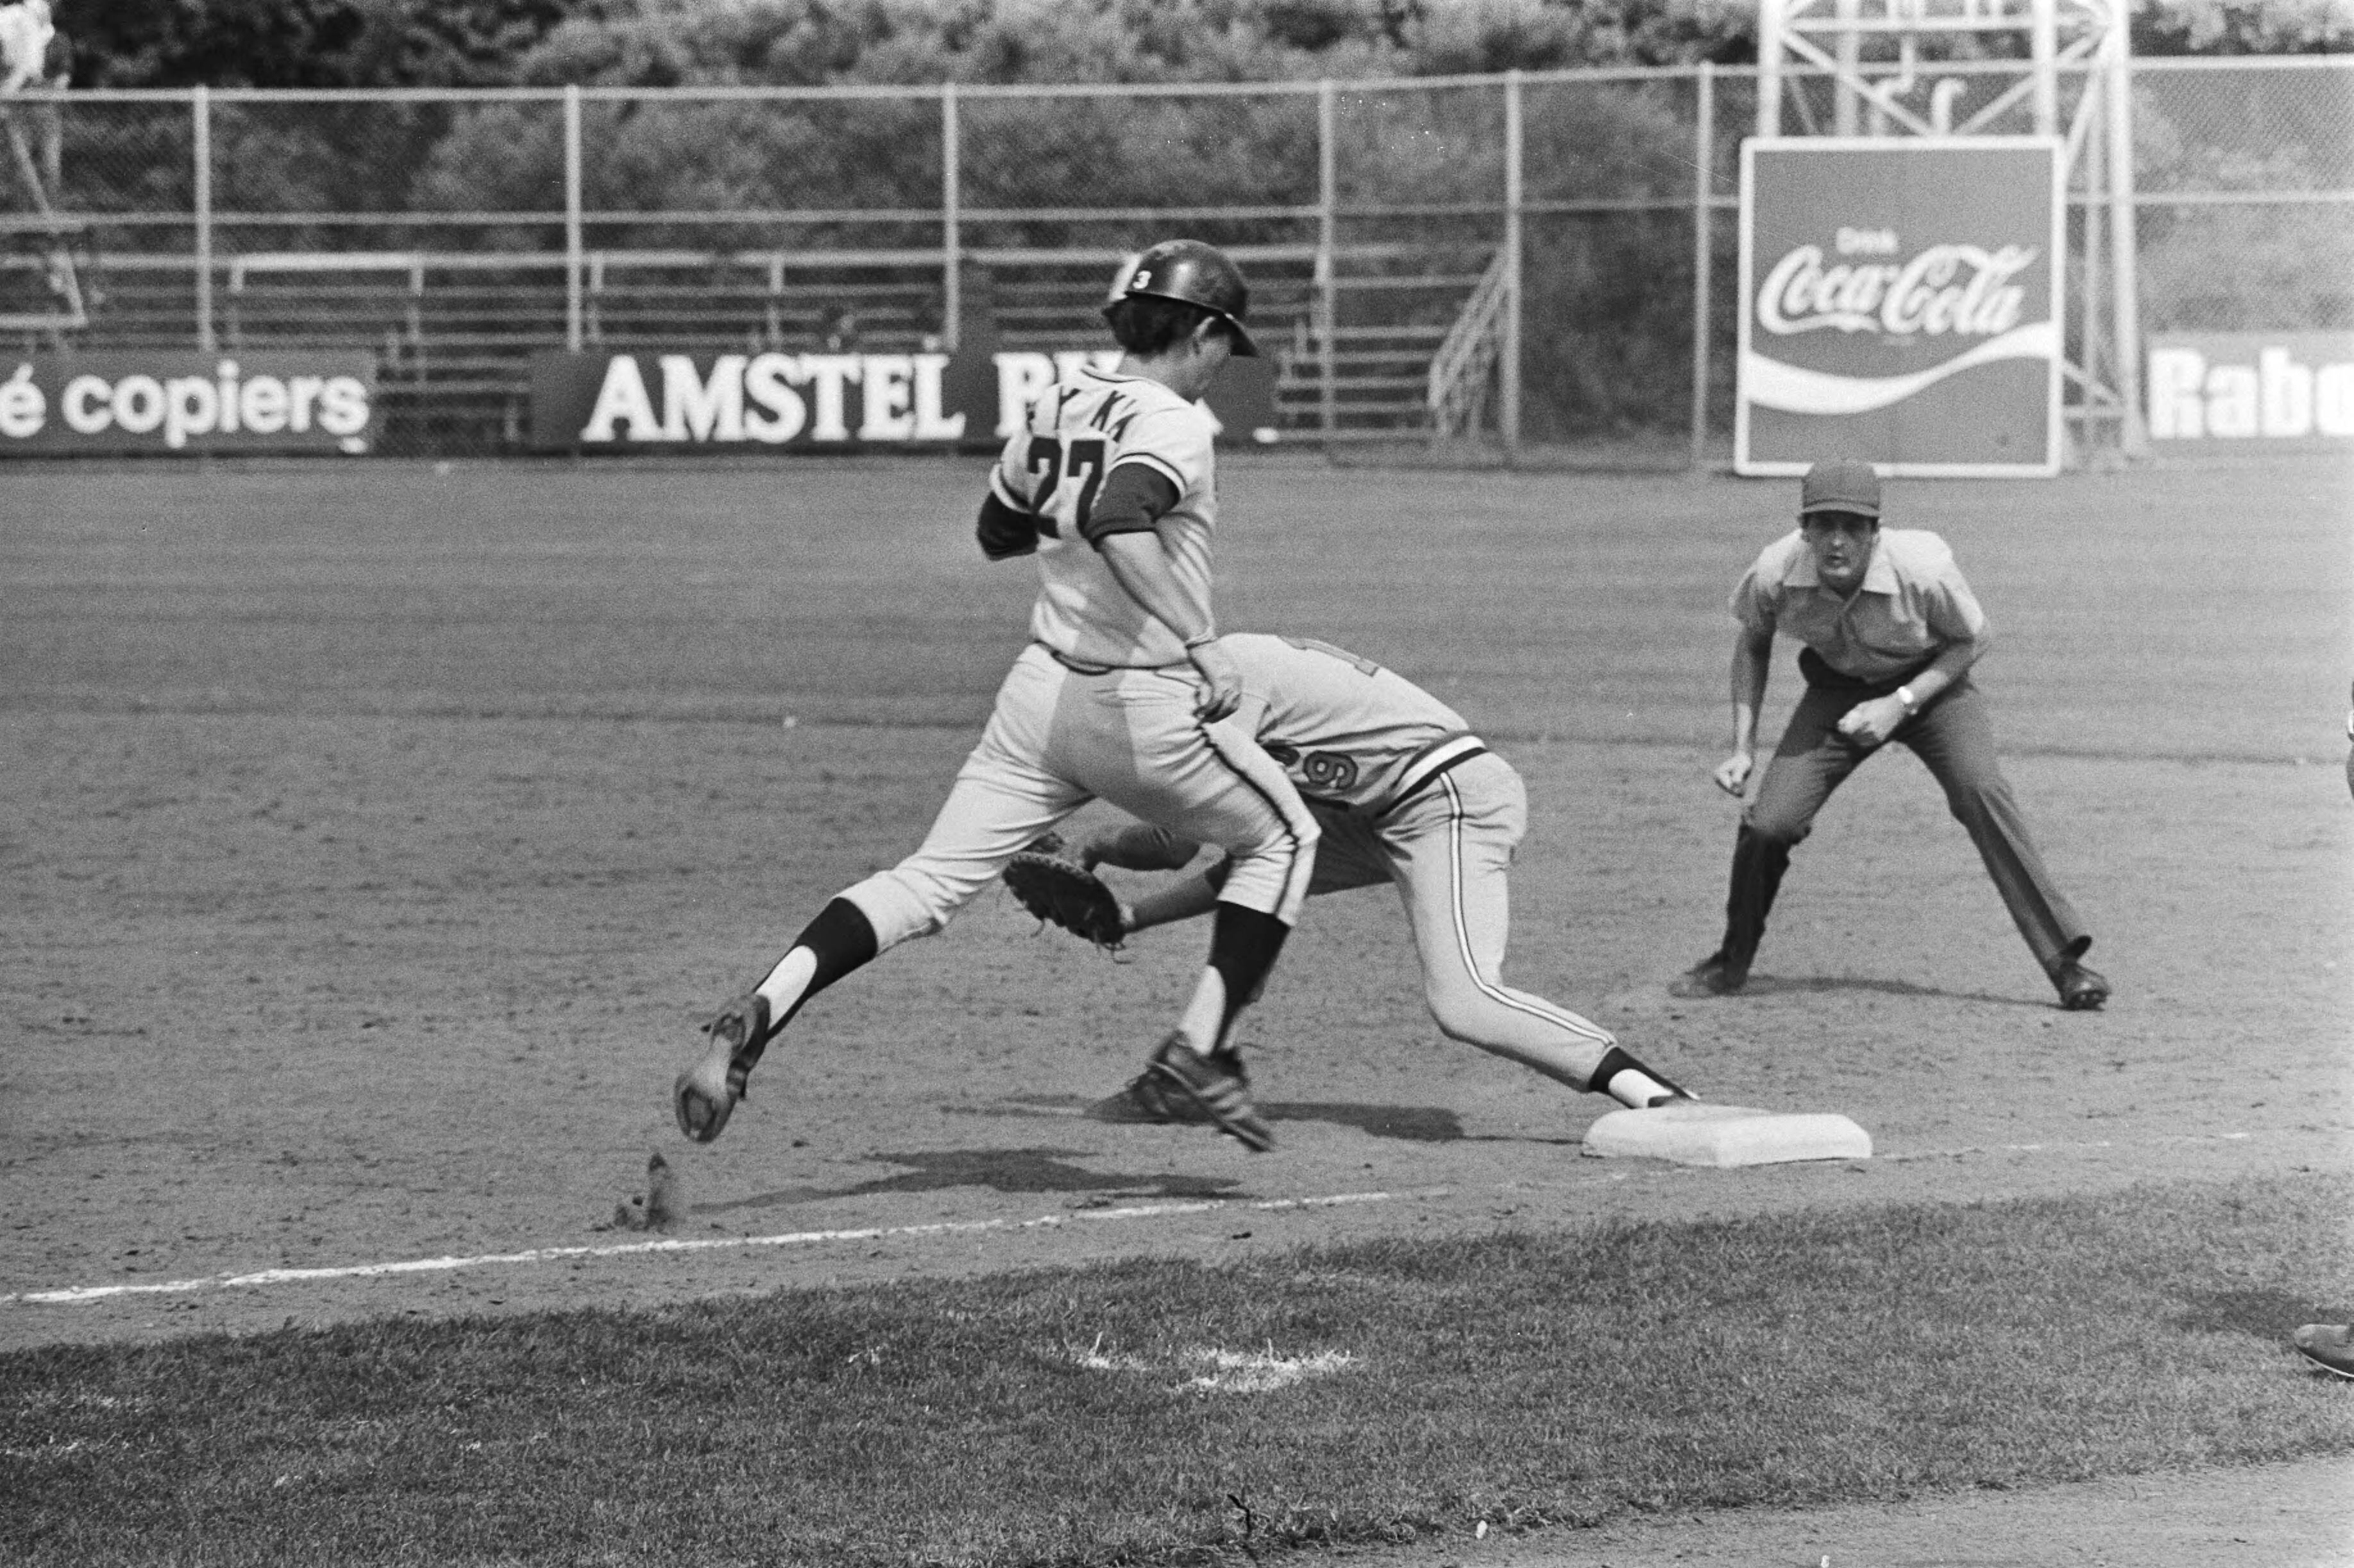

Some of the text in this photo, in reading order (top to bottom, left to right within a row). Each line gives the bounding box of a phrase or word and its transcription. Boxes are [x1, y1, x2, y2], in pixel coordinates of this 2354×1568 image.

[1132, 270, 1152, 289] 3
[1757, 245, 2040, 335] Coca-Cola
[62, 358, 371, 449] copiers
[580, 351, 967, 444] AMSTEL
[1026, 436, 1106, 539] 27
